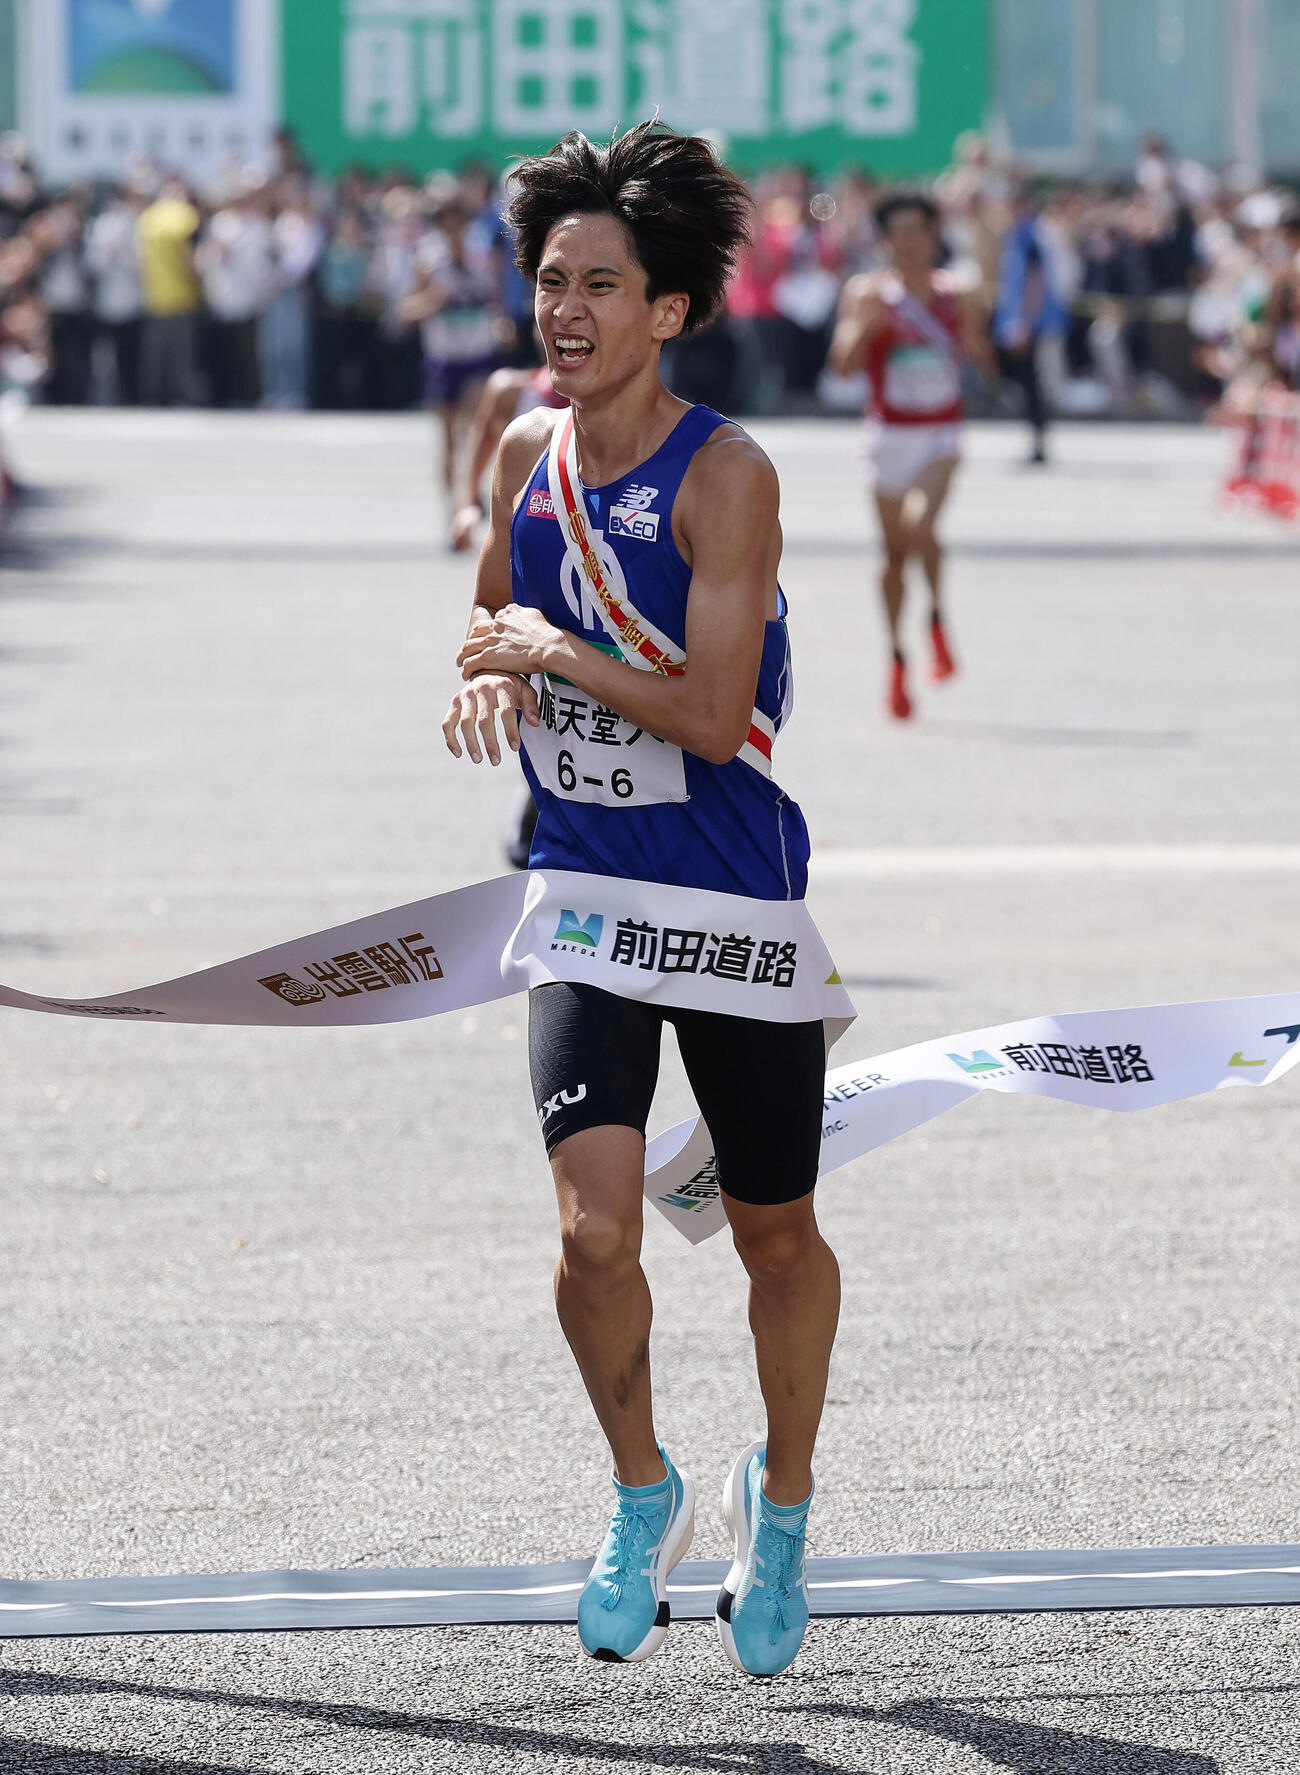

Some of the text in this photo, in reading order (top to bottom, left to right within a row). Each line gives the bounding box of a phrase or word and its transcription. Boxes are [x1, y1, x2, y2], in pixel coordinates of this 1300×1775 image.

[304, 932, 444, 998] 出雲駅伝
[551, 943, 596, 957] MAEDA
[610, 917, 797, 988] 前田道路
[1000, 1043, 1155, 1084] 前田道路
